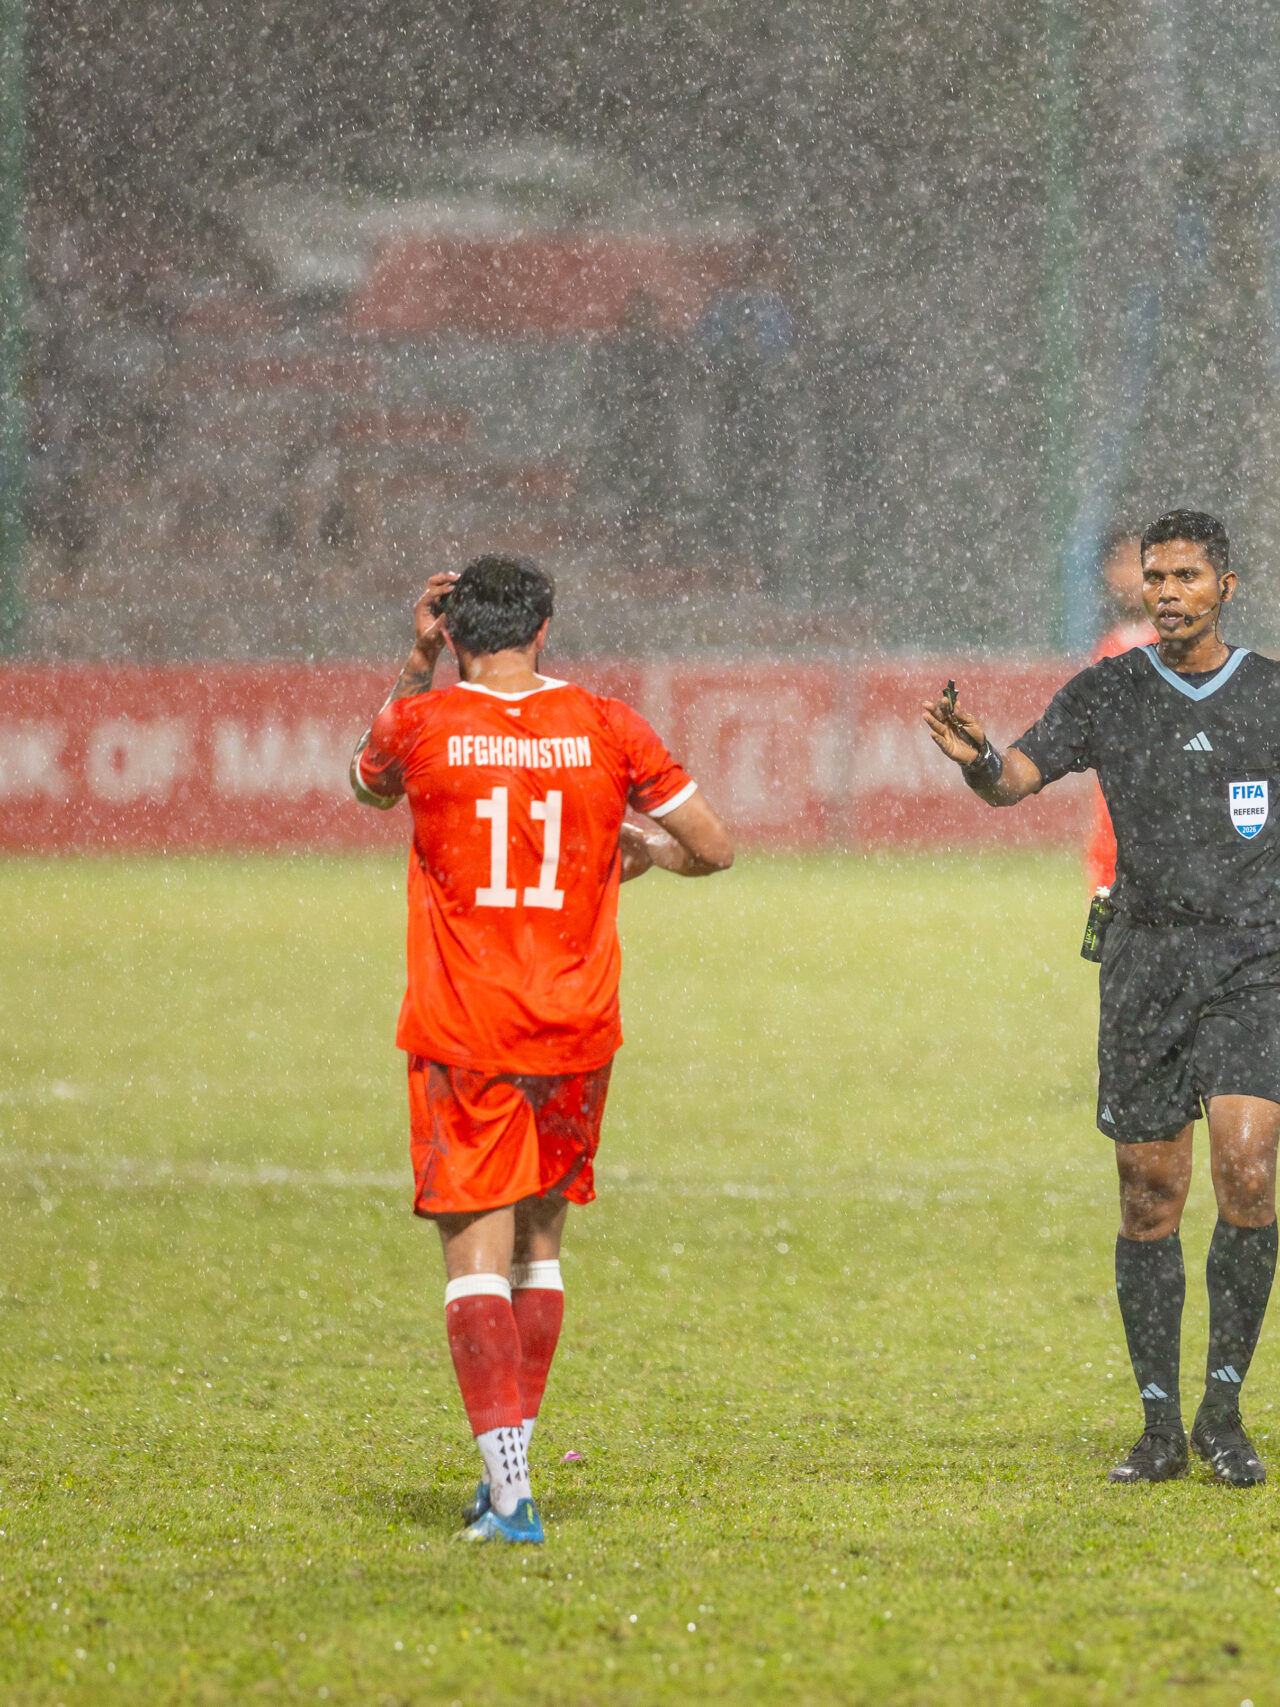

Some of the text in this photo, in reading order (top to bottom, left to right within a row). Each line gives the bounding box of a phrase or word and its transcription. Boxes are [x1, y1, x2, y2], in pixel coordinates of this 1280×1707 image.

[447, 735, 592, 769] AFGHANISTAN
[1232, 785, 1265, 800] FIFA
[1233, 807, 1265, 816] REFEREE
[1242, 826, 1257, 834] 2026
[475, 786, 565, 910] 11
